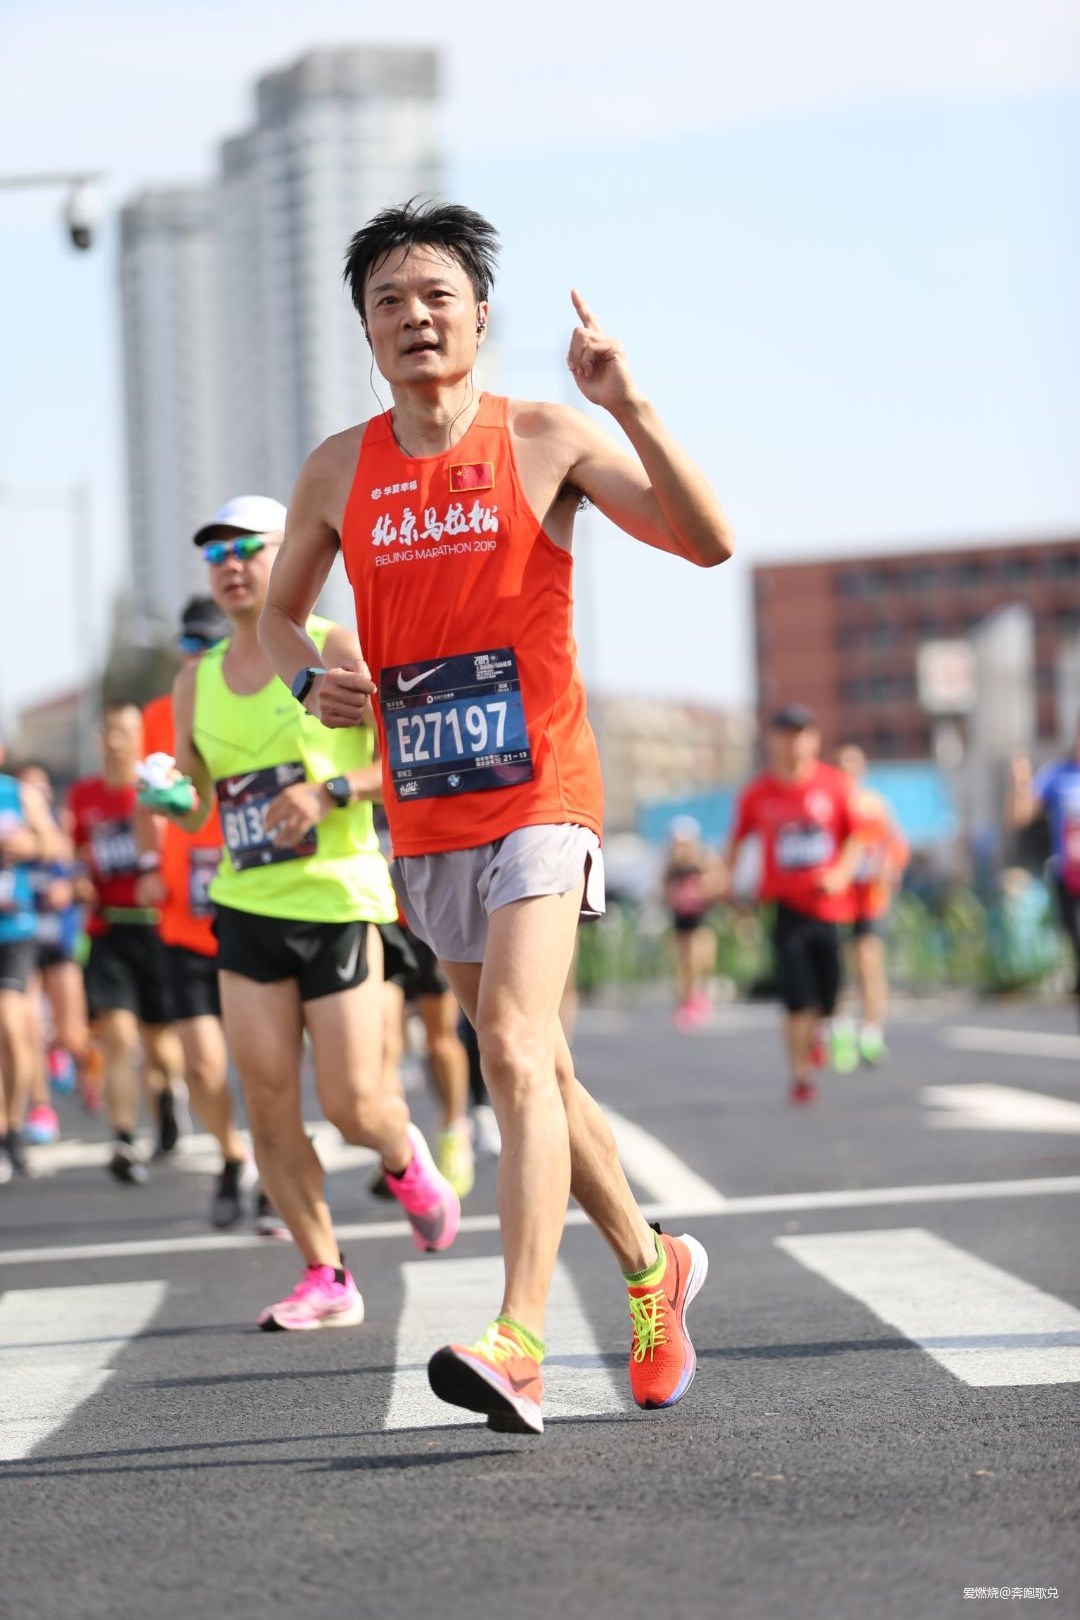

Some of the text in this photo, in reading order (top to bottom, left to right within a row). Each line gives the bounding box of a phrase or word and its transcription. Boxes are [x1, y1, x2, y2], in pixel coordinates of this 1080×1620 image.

[383, 480, 418, 495] 华夏幸福
[371, 500, 499, 546] 北京马拉松
[375, 541, 497, 566] BEIJING MARATHON 2019
[397, 701, 508, 763] E27197
